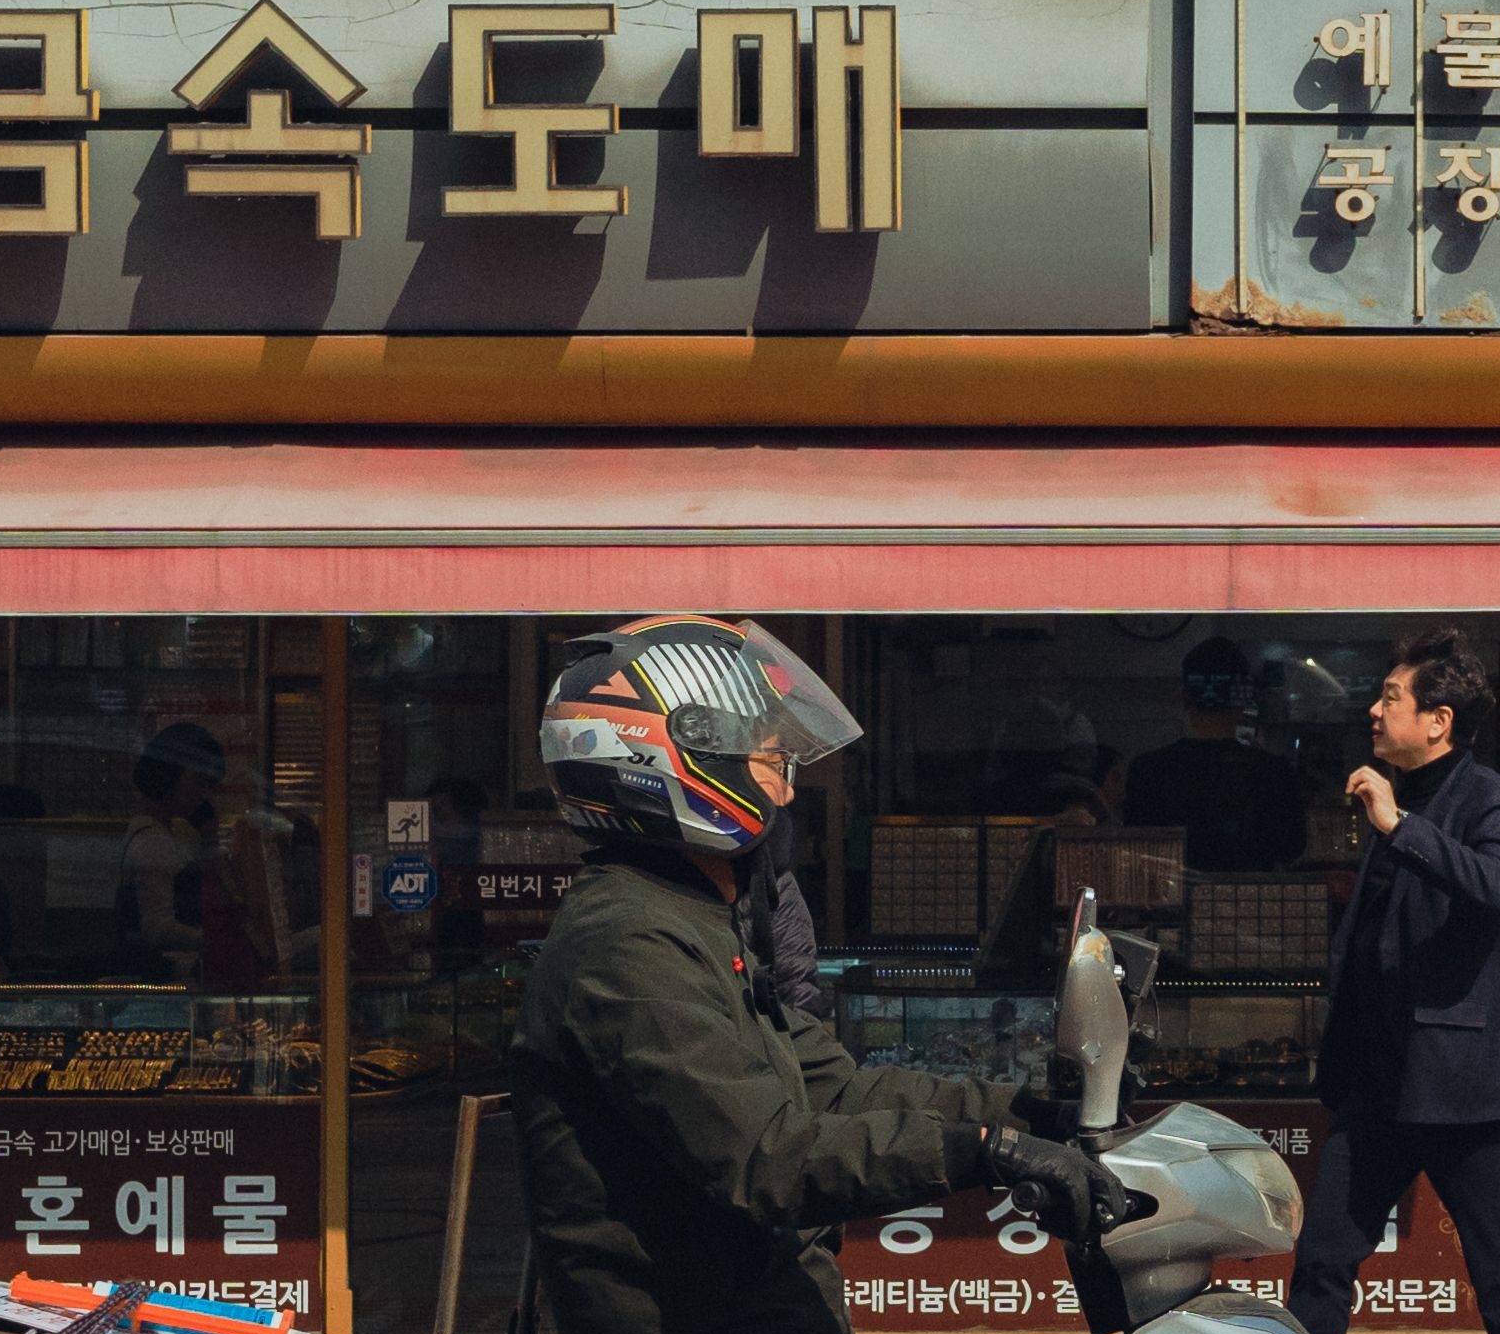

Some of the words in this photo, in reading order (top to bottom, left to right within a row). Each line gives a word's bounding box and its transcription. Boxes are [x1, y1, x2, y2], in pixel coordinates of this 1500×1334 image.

[389, 873, 429, 894] ADT
[476, 874, 543, 899] 일번지
[1250, 1126, 1313, 1155] 제품
